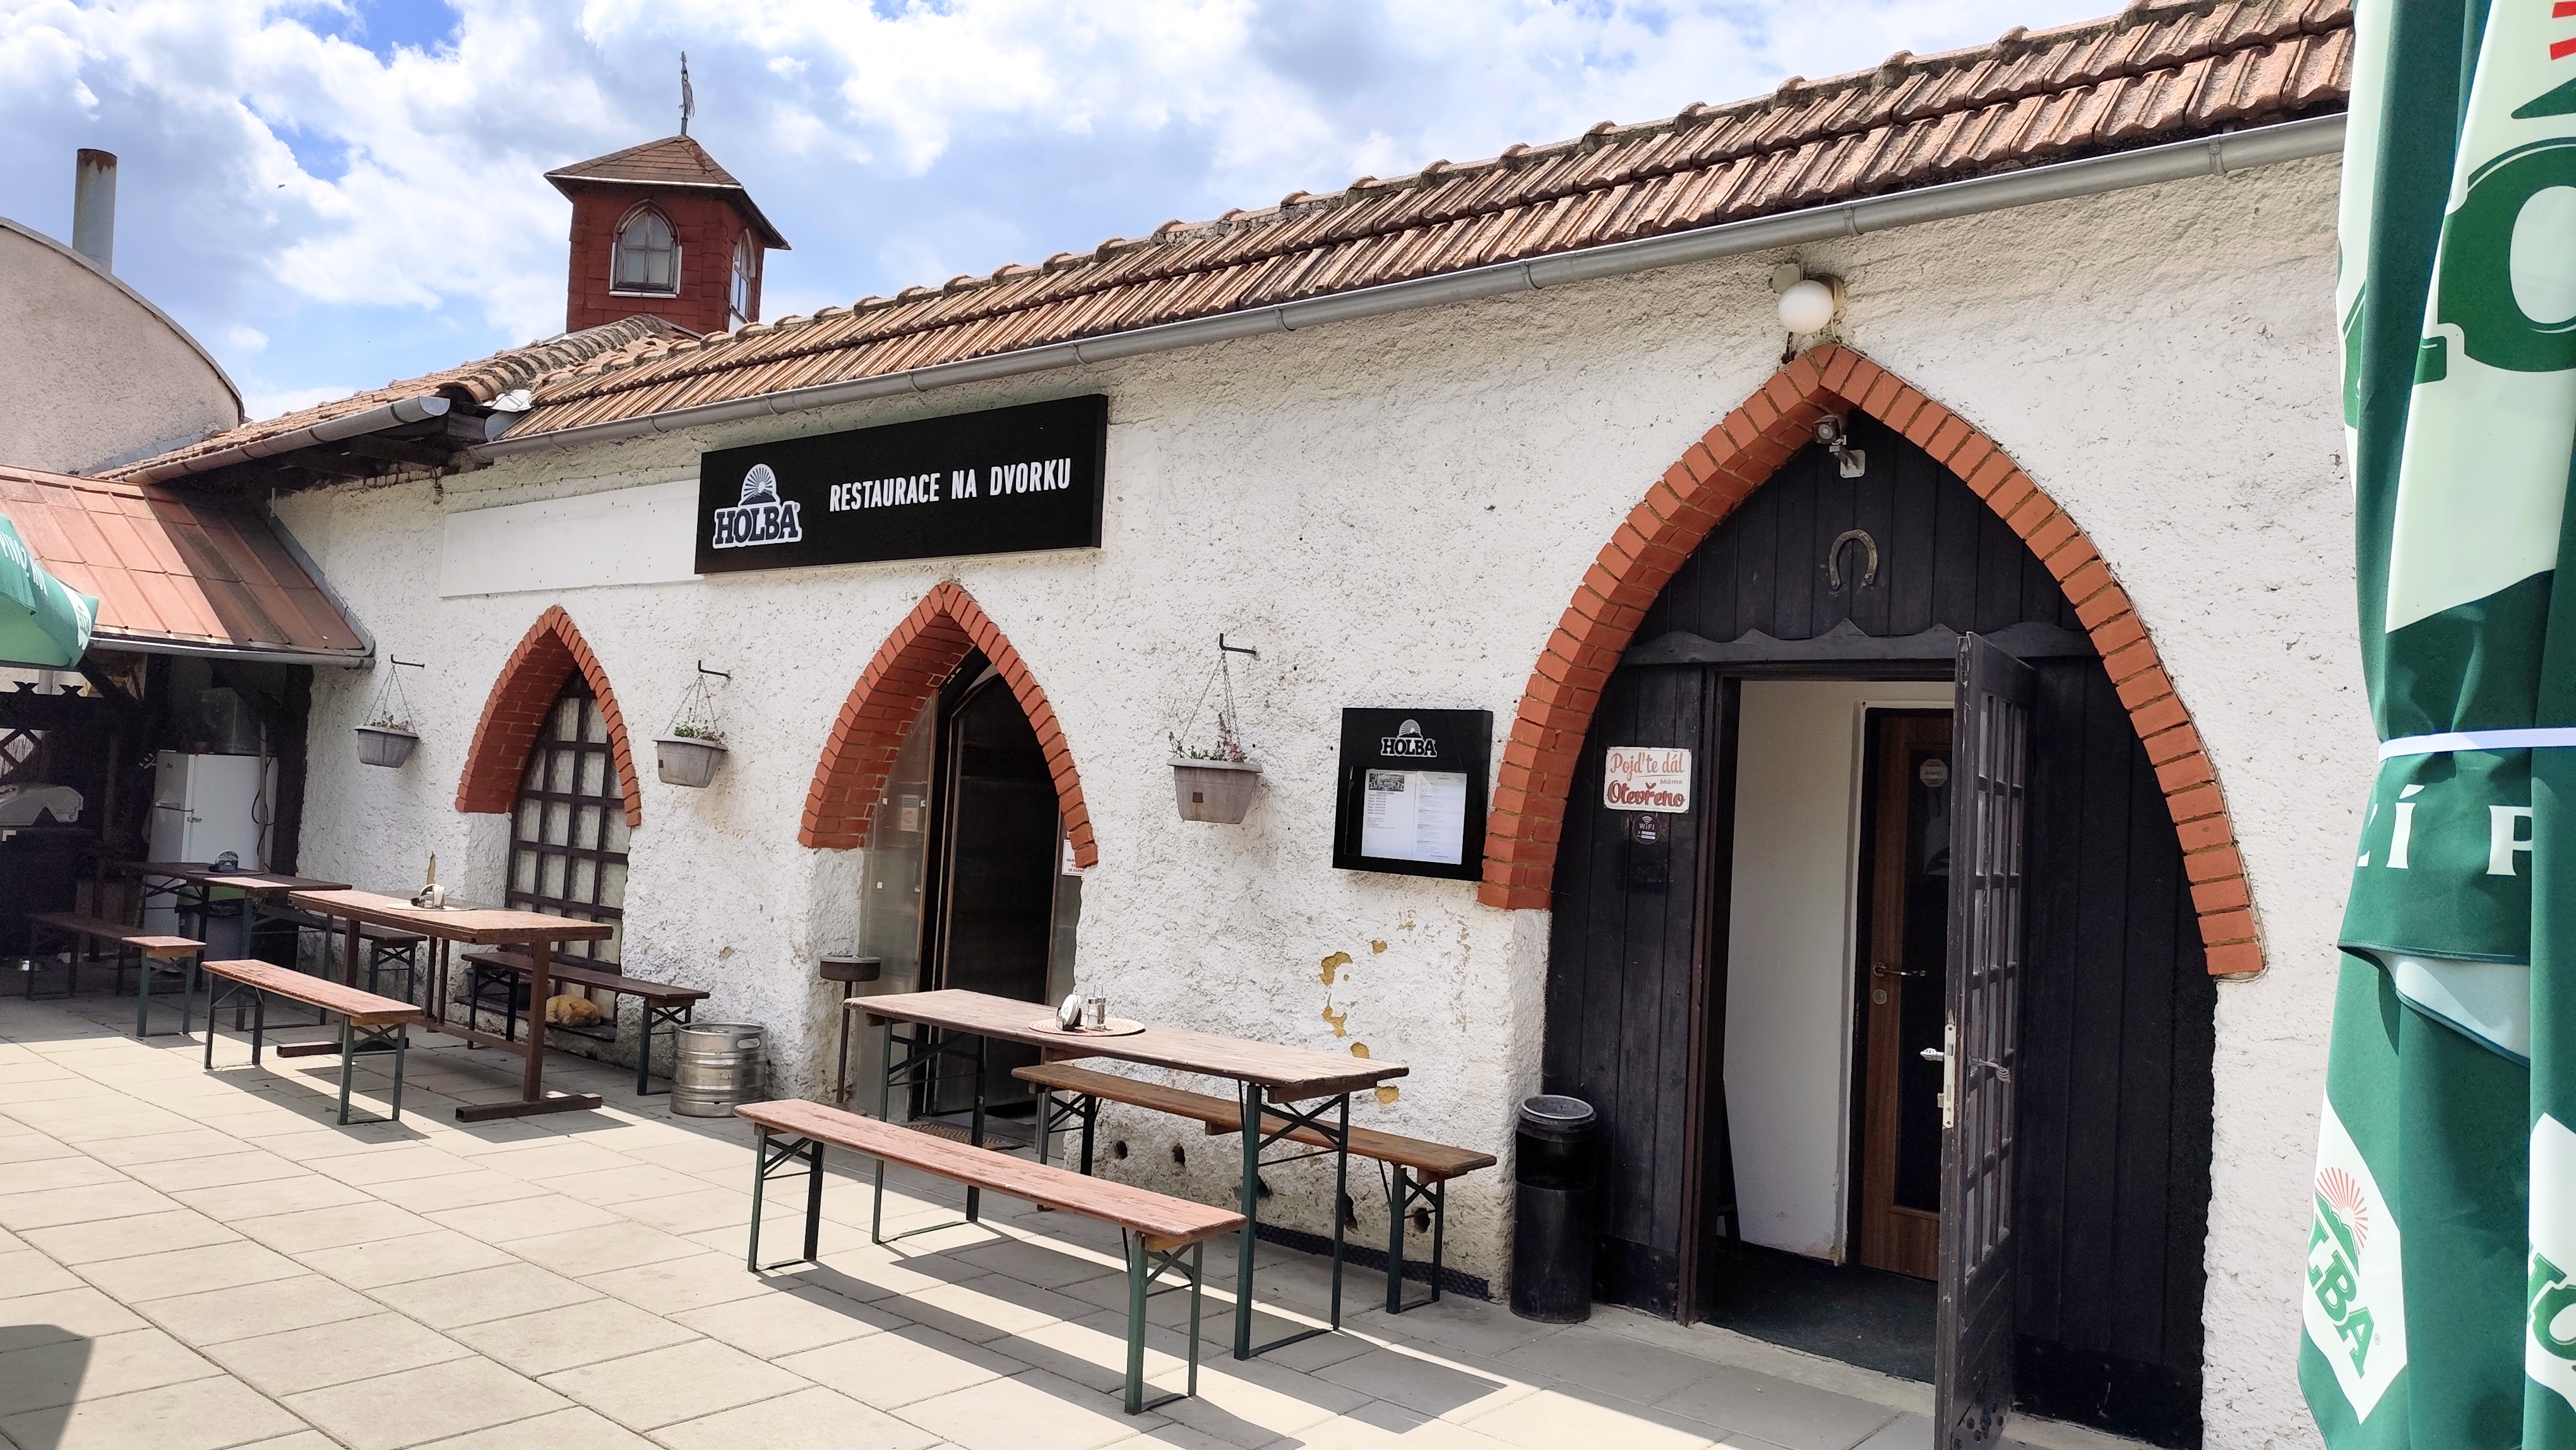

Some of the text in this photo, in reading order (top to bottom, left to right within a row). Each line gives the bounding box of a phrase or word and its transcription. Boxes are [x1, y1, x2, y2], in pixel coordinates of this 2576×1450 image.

[830, 457, 1071, 512] RESTAURACE NA DVORKU
[714, 503, 799, 545] HOLBA
[1381, 738, 1436, 756] HOLBA
[1662, 752, 1685, 773] dál
[1607, 779, 1686, 807] Otevřeno
